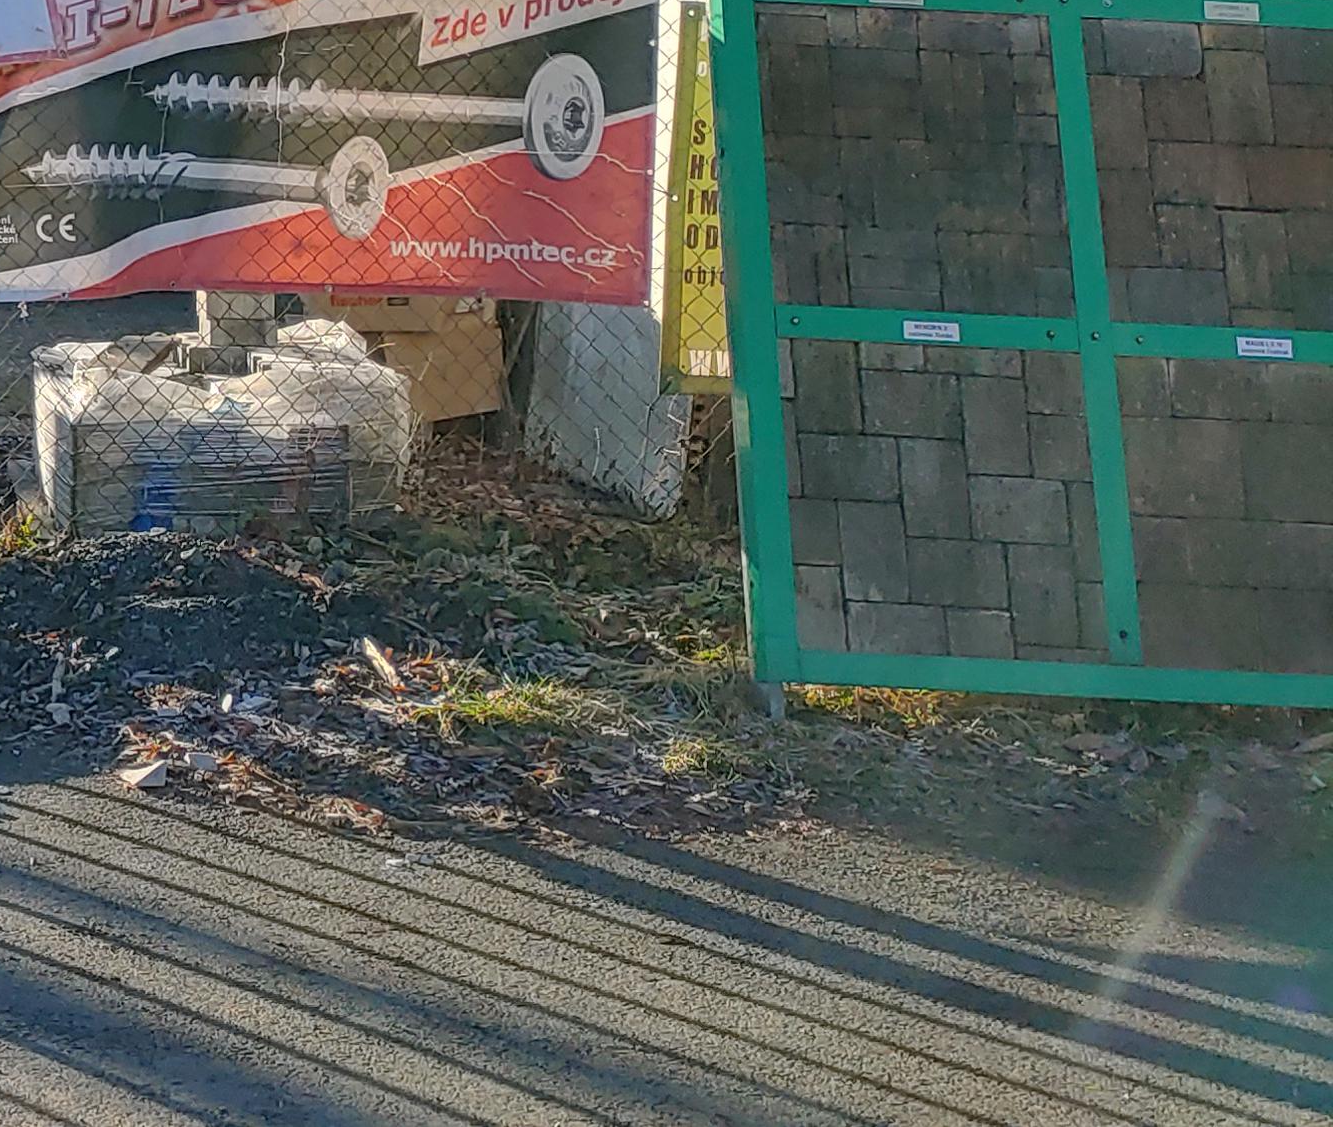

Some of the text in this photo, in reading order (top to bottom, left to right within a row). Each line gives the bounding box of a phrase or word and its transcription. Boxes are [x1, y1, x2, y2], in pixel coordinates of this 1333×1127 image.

[432, 8, 488, 48] Zde
[500, 9, 515, 28] v
[390, 237, 616, 265] www.hpmtec.cz
